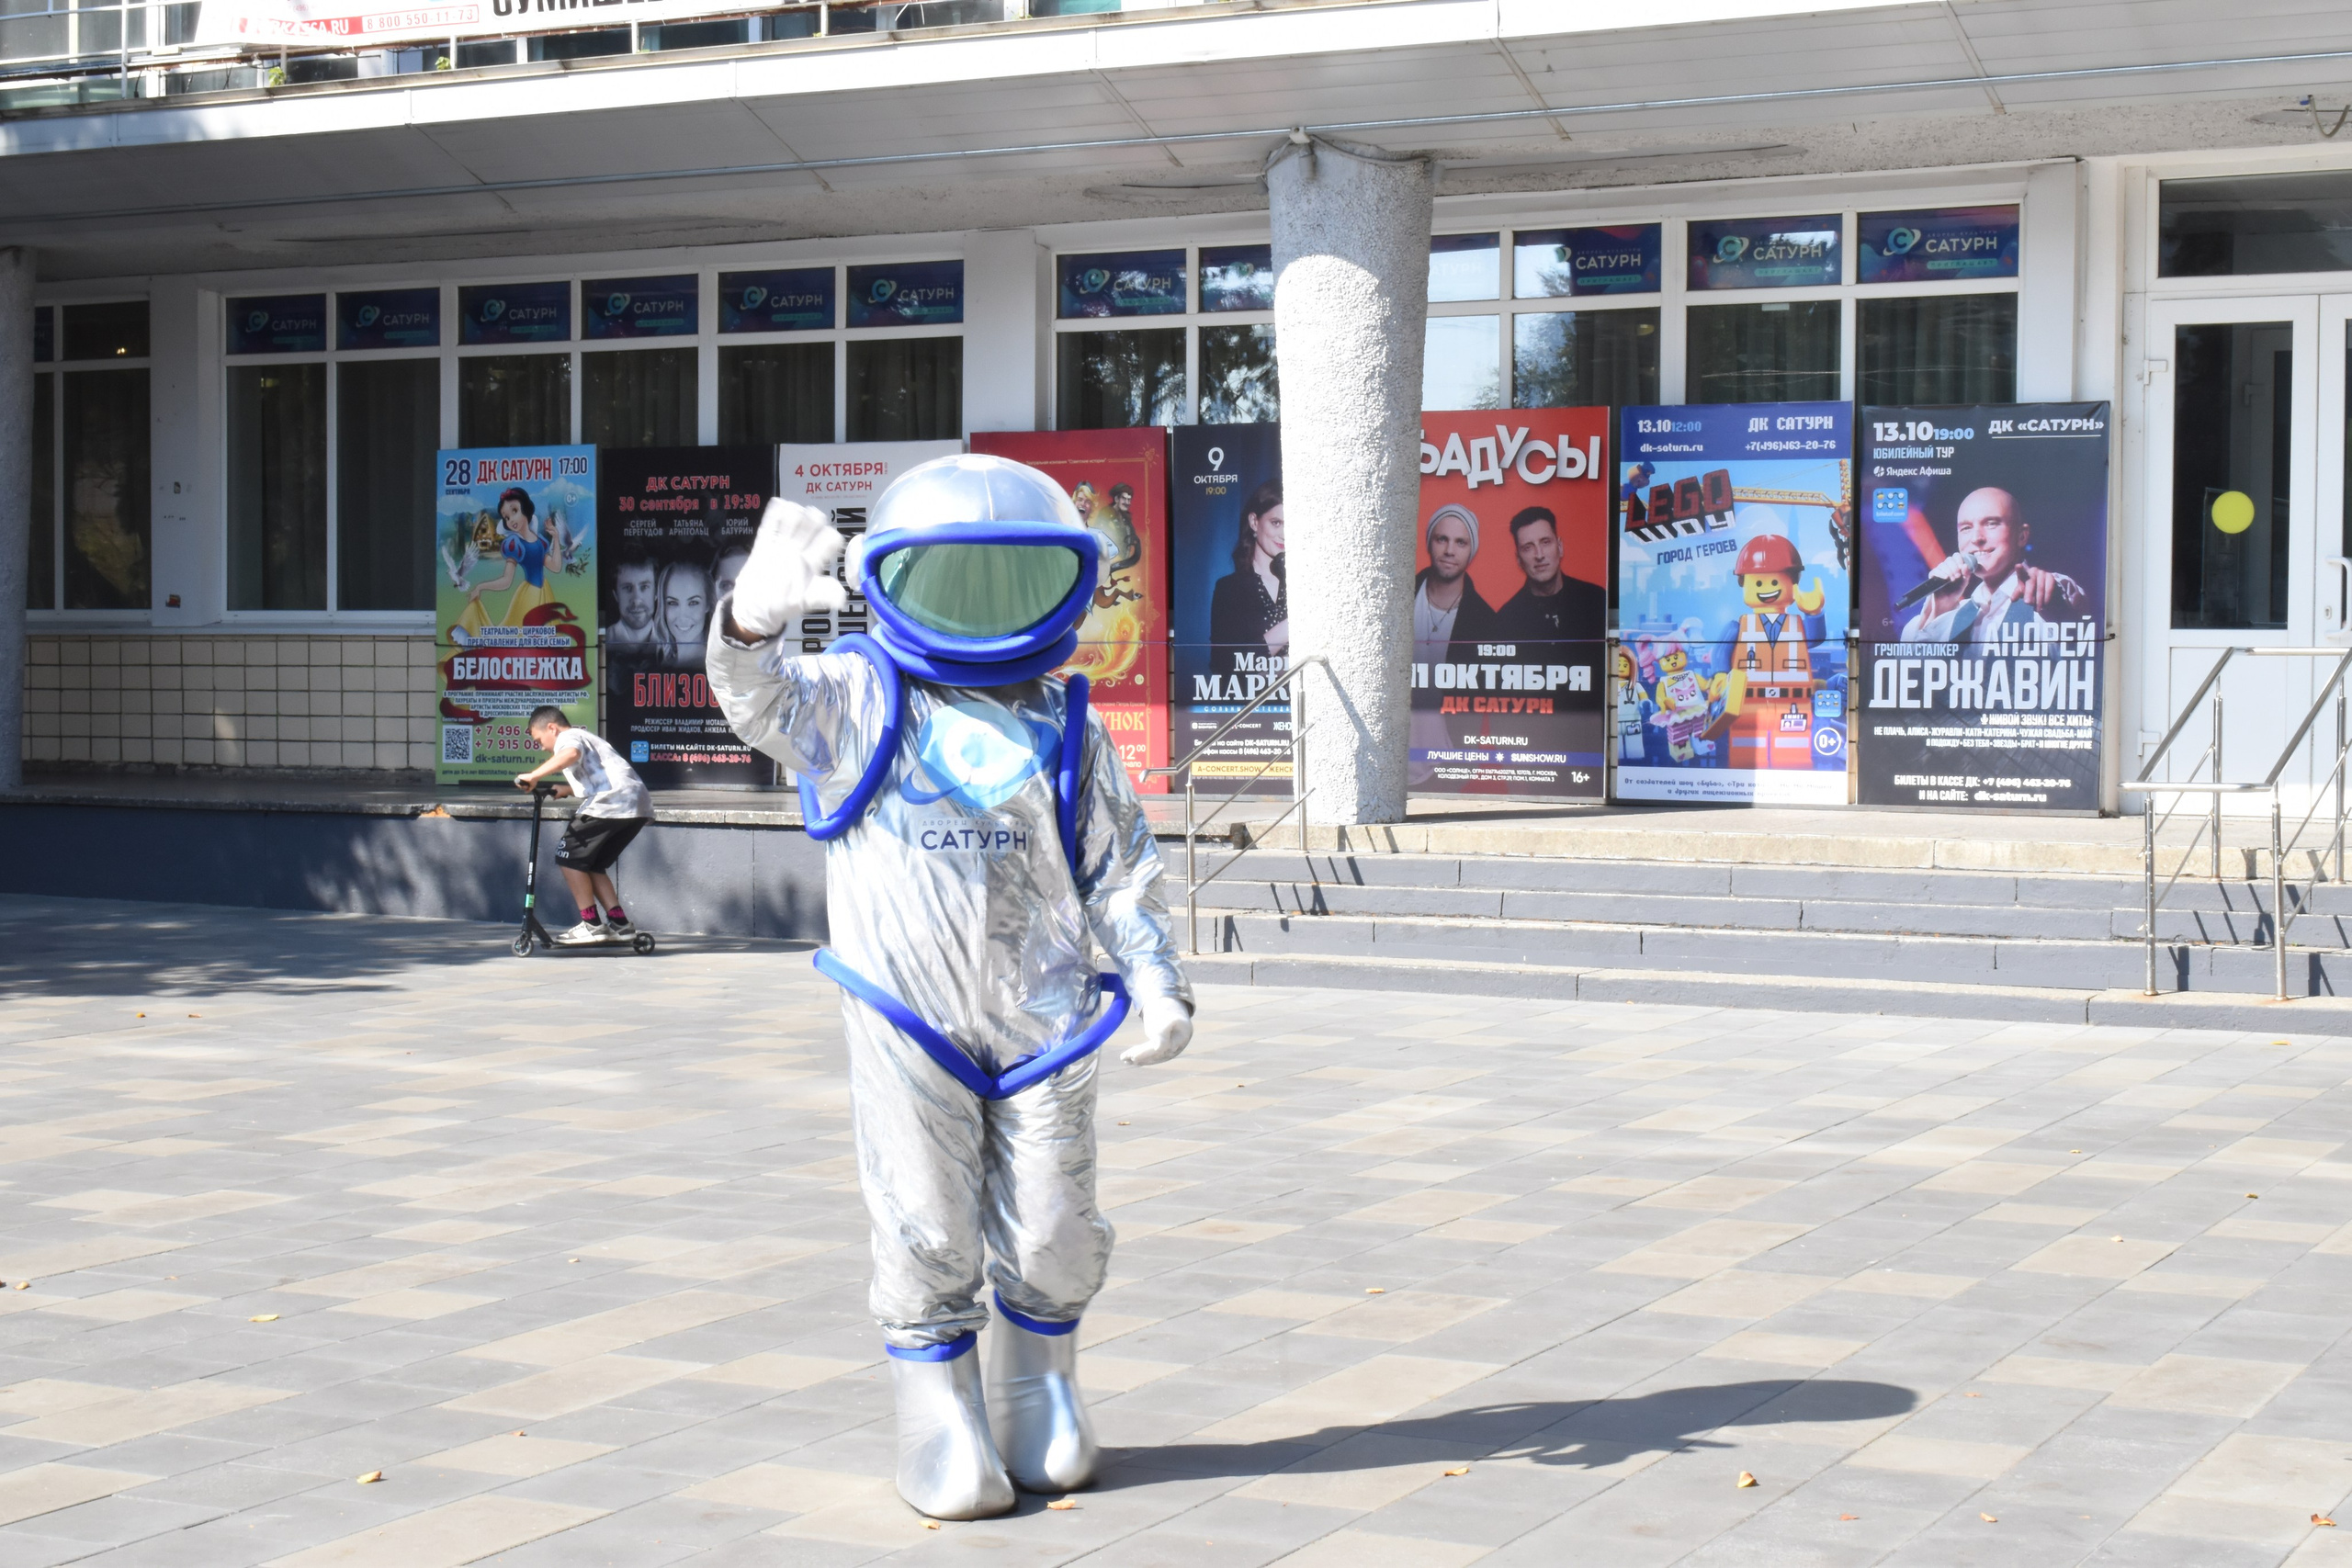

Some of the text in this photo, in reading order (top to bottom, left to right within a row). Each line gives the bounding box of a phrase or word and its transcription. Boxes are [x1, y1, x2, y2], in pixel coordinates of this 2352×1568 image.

[368, 8, 473, 29] 8 800 550-11-73
[1925, 236, 1997, 253] САТУРН
[1753, 244, 1822, 260] САТУРН
[1576, 254, 1641, 269] САТУРН
[771, 293, 823, 309] САТУРН
[900, 286, 954, 302] САТУРН
[634, 299, 684, 314] САТУРН
[383, 312, 429, 326] САТУРН
[509, 307, 558, 321] САТУРН
[272, 318, 316, 332] САТУРН
[1637, 415, 1834, 434] 13.10 12:00 ДК САТУРН
[1873, 418, 2105, 442] 13.10 19:00 ДК «САТУРН»
[1640, 443, 1703, 453] dk-saturn.ru
[1873, 445, 1954, 459] ЮБИЛЕЙНЫЙ ТУР
[1208, 447, 1224, 471] 9
[445, 457, 587, 486] 28 ДК САТУРН 17:00
[795, 465, 804, 477] 4
[810, 462, 883, 477] ОКТЯБРЯ
[1886, 467, 1951, 477] Яндекс Афиша
[646, 476, 729, 492] ДК САТУРН
[1193, 474, 1238, 484] ОКТЯБРЯ
[806, 481, 872, 493] ДК САТУРН
[1205, 486, 1227, 495] 19:00
[619, 494, 761, 513] 30 сентября в 19:30
[1625, 468, 1735, 530] LEGO
[630, 517, 749, 527] СЕРГЕЙ ТАТЬЯНА ЮРИЙ
[1625, 511, 1736, 545] ШОУ
[624, 526, 753, 536] ПЕРЕГУДОВ АРНТГОЛЬЦ БАТУРИН
[1657, 538, 1737, 565] ГОРОД ГЕРОЕВ
[1881, 617, 1894, 626] 6+
[481, 626, 555, 636] ТЕАТРАЛЬНО ЦИРКОВОЕ
[1982, 615, 2096, 658] АНДРЕЙ
[518, 638, 532, 647] ДЛЯ
[534, 637, 548, 646] ВСЕЙ
[548, 637, 570, 646] СЕМЬИ
[1477, 644, 1516, 657] 19:00
[1874, 643, 1960, 657] ГРУППА СТАЛКЕР
[453, 657, 583, 680] БЕЛОСНЕЖКА
[1434, 663, 1591, 691] ОКТЯБРЯ
[1193, 674, 1291, 700] МАРК
[1868, 659, 2095, 710] ДЕРЖАВИН
[1440, 696, 1555, 715] ДК САТУРН
[1988, 712, 2094, 726] ЖИВОЙ ЗВУК! ВСЕ ХИТЫ:
[497, 726, 520, 736] 496
[1874, 727, 1883, 736] НЕ
[1907, 728, 1928, 736] АЛИСА
[1931, 728, 1963, 737] ЖУРАВЛИ
[498, 739, 519, 750] 915
[1464, 736, 1528, 746] DK-SATURN.RU
[1820, 735, 1836, 748] 0+
[476, 754, 535, 763] dk-saturn.ru
[650, 753, 681, 761] КАССА:
[1427, 751, 1489, 761] ЛУЧШИЕ ЦЕНЫ
[1510, 753, 1566, 763] SUNSHOW.RU
[1571, 771, 1590, 783] 16+
[1894, 774, 1929, 785] БИЛЕТЫ
[1930, 775, 1937, 785] В
[1938, 776, 1964, 786] КАССЕ
[1965, 776, 1981, 787] ДК:
[1927, 790, 1939, 800] НА
[1939, 789, 1968, 801] САЙТЕ:
[1974, 791, 2047, 802] dk-saturn.ru
[921, 829, 1027, 851] САТУРН
